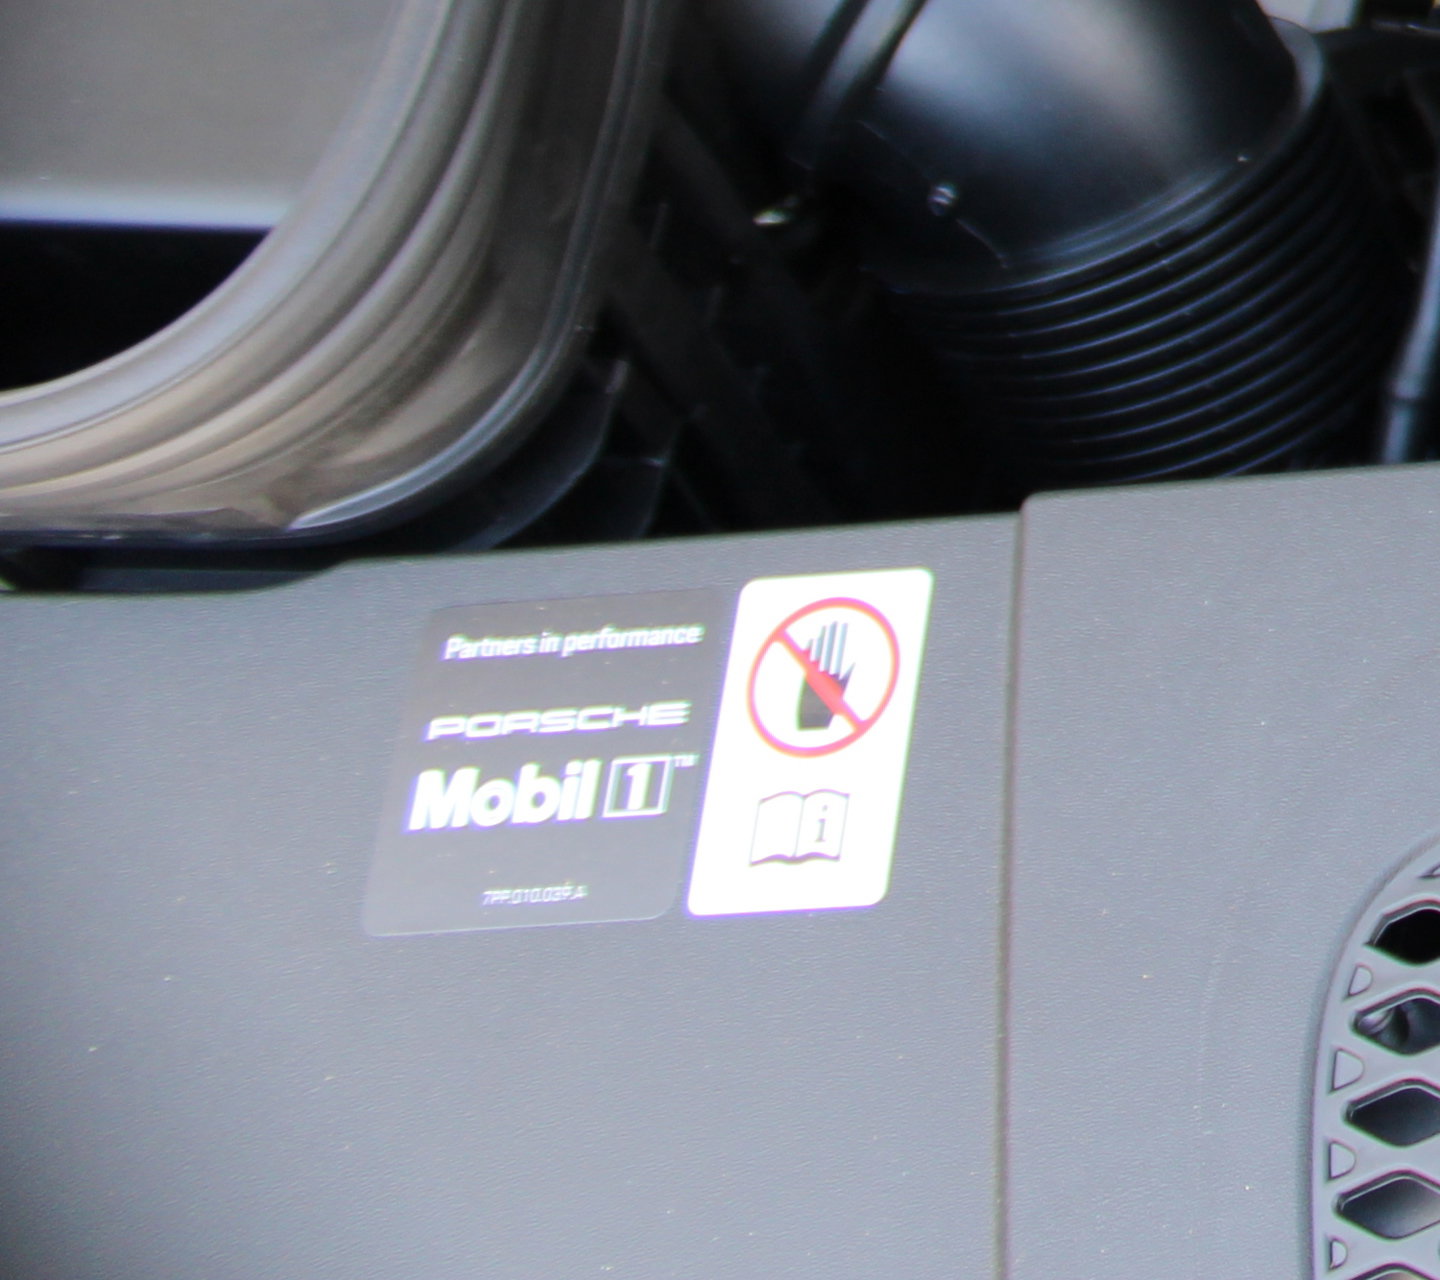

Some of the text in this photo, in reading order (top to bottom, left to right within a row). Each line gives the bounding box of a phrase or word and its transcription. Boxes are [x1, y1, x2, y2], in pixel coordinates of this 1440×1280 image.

[442, 623, 705, 660] Partners in performance
[425, 700, 692, 741] PORSCHE
[406, 758, 602, 832] Mobil
